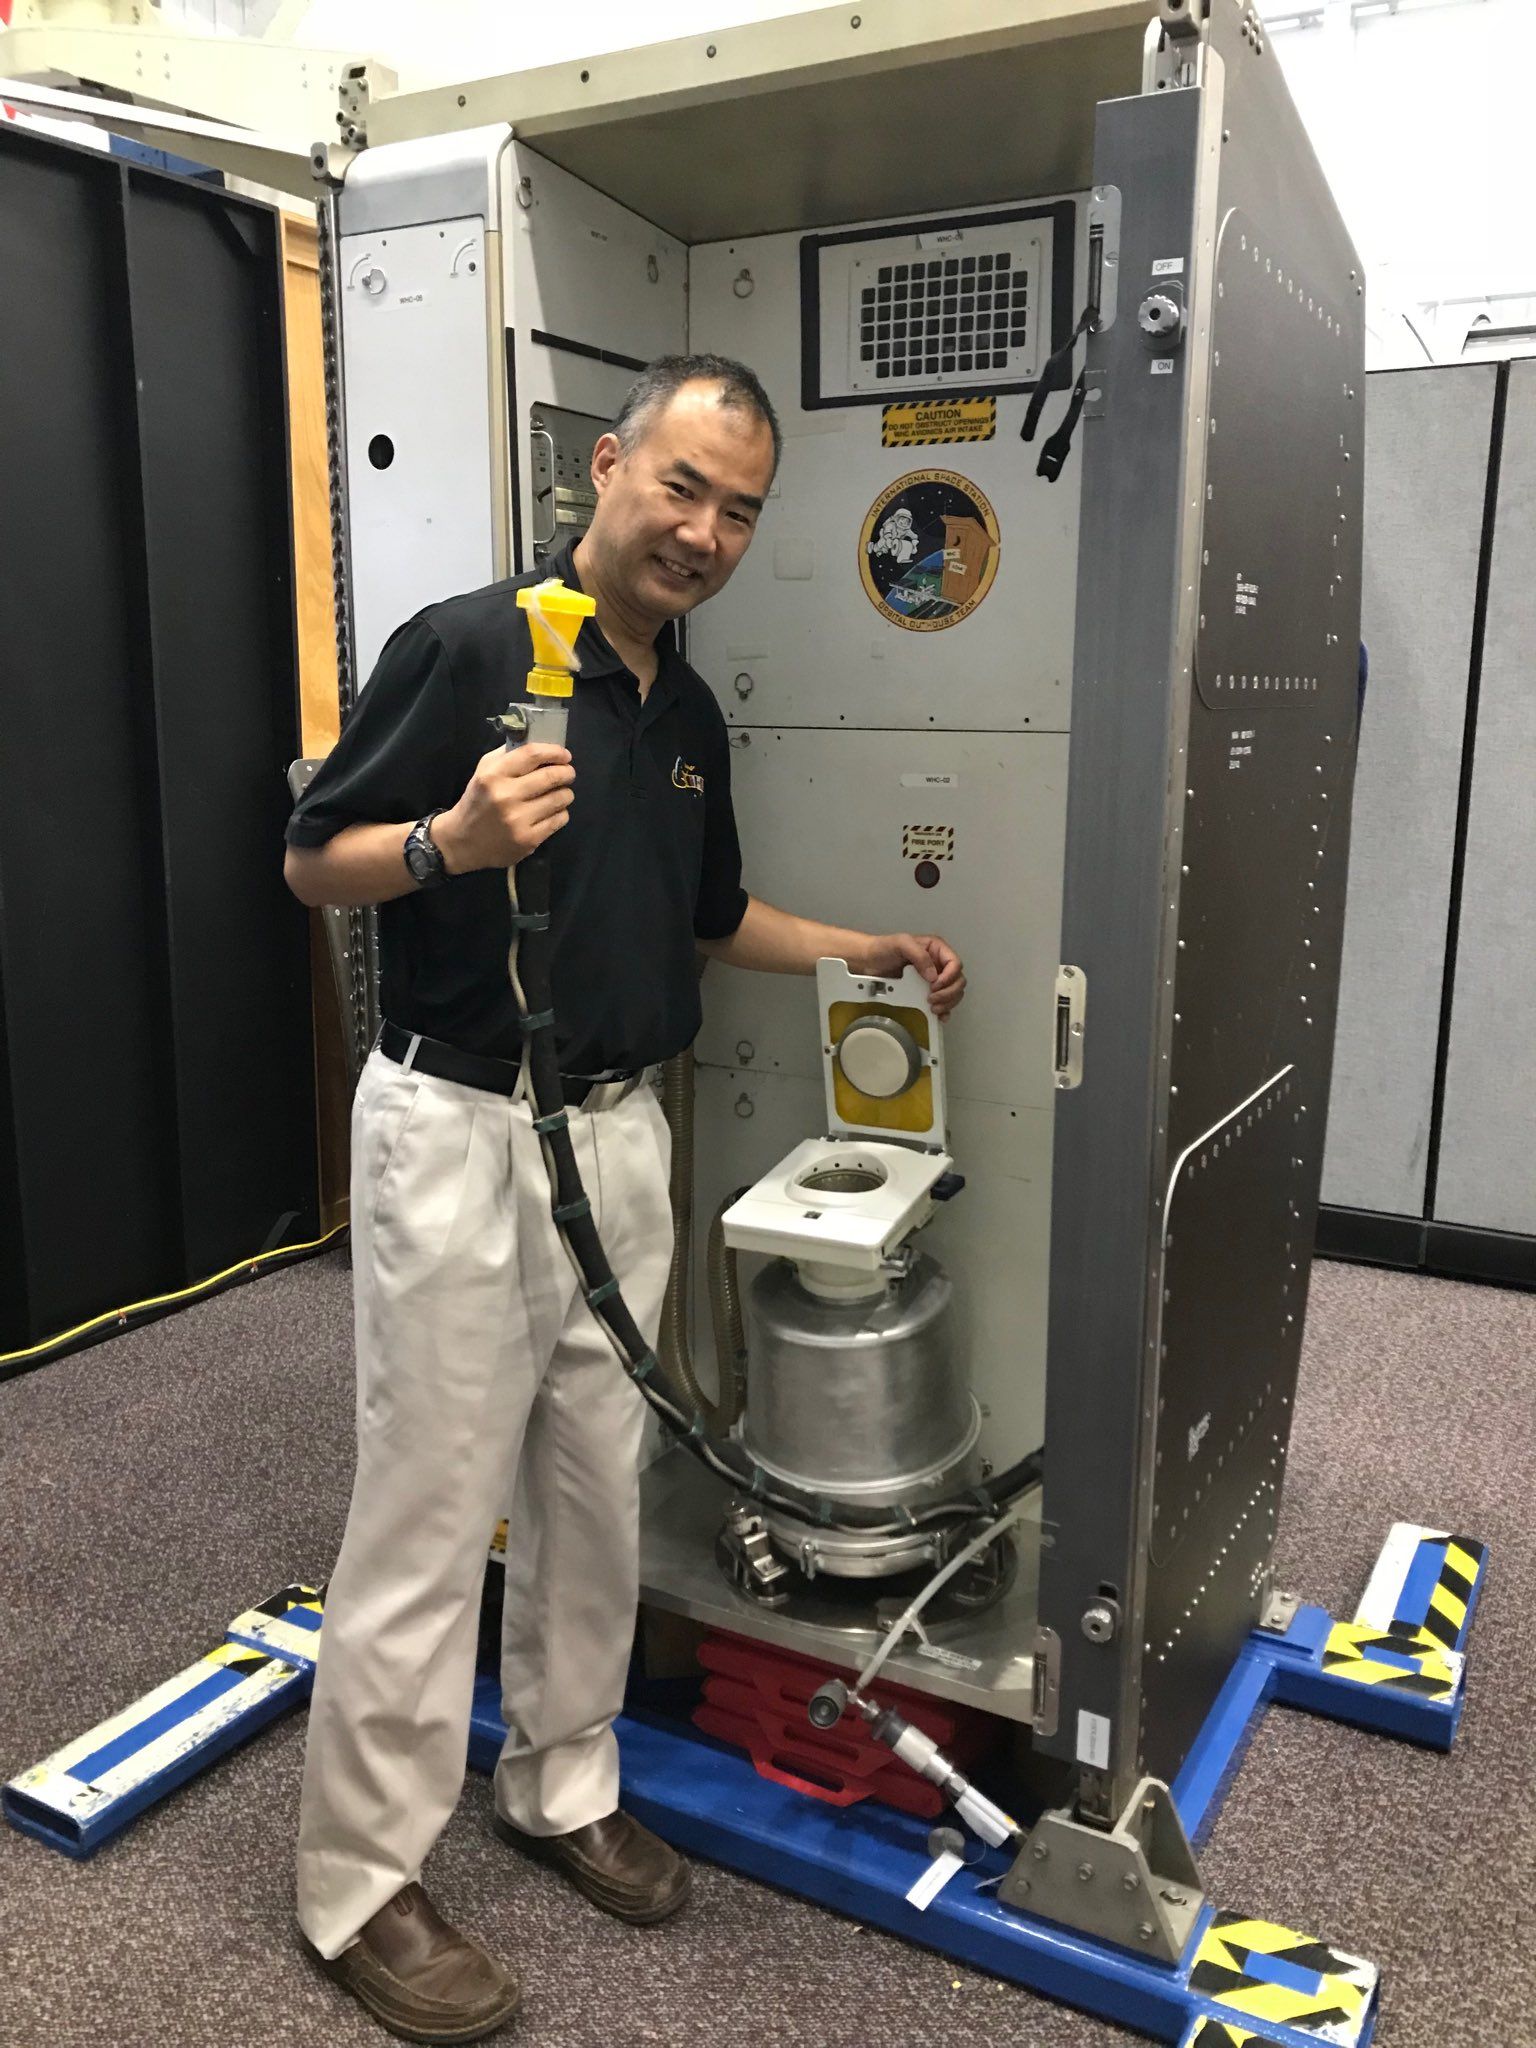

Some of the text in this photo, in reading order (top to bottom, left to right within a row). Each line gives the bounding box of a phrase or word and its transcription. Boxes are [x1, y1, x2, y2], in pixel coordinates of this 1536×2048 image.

[1155, 261, 1173, 272] OFF
[1157, 361, 1171, 371] ON
[915, 408, 962, 421] CAUTION
[888, 423, 899, 431] DO
[915, 420, 952, 430] OBSTRUCT
[953, 417, 989, 426] OPENINGS
[911, 428, 943, 437] AVIONICS
[958, 425, 983, 433] INTAKE
[871, 473, 990, 517] INTERNATIONAL SPACE STATION
[878, 602, 906, 626] ORBITAL
[957, 599, 976, 618] TEAM
[927, 839, 945, 847] PORT
